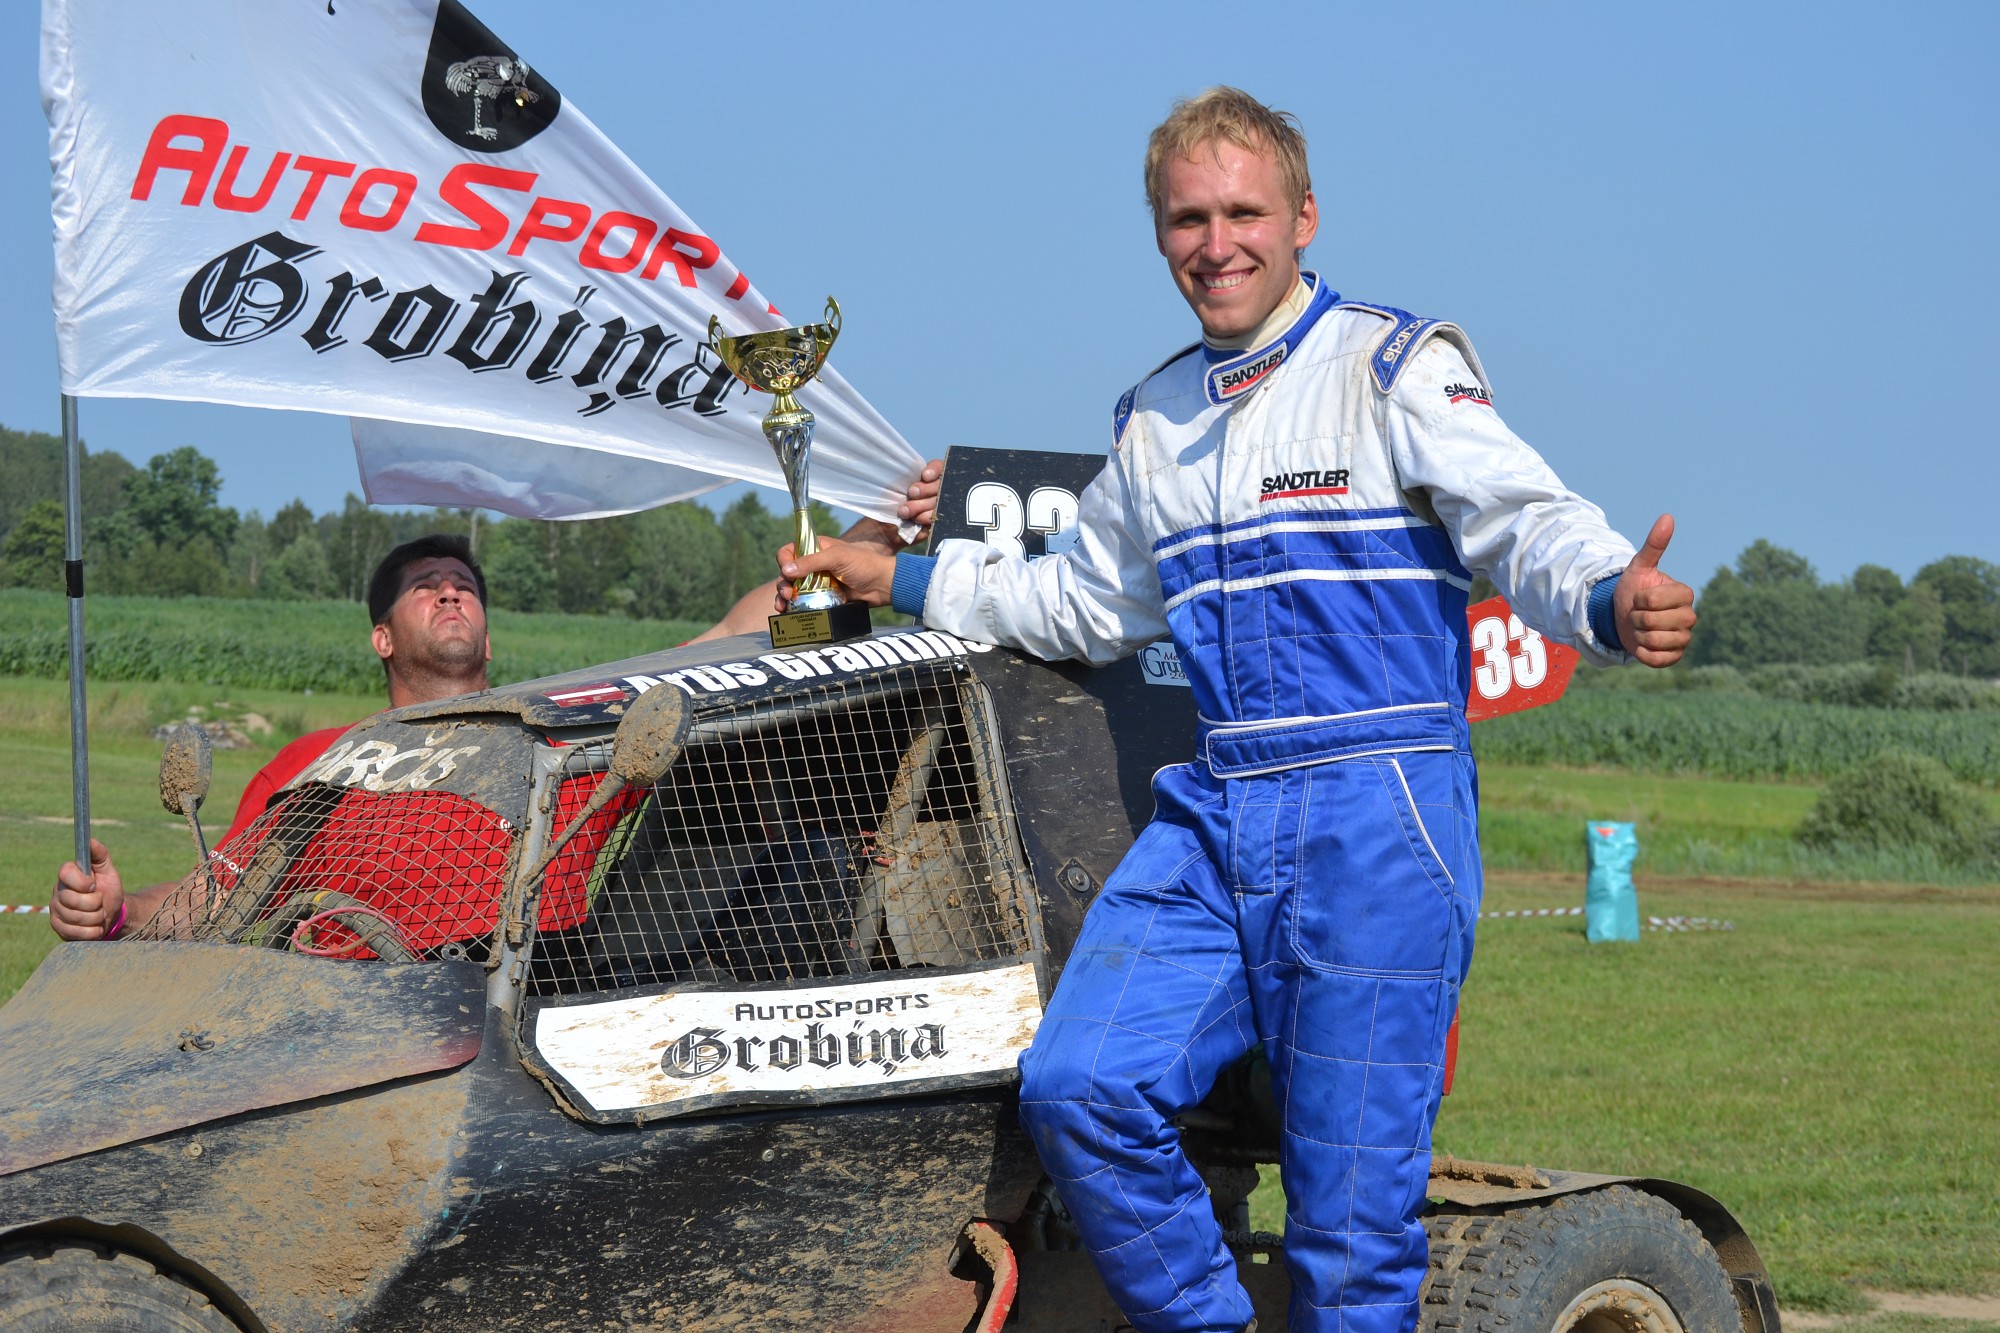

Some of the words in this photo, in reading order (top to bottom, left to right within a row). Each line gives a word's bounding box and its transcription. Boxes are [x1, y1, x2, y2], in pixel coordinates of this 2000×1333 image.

[1222, 350, 1283, 389] SANDTLER
[1261, 469, 1350, 494] SANDTLER
[773, 620, 785, 635] 1.
[1472, 611, 1548, 699] 33
